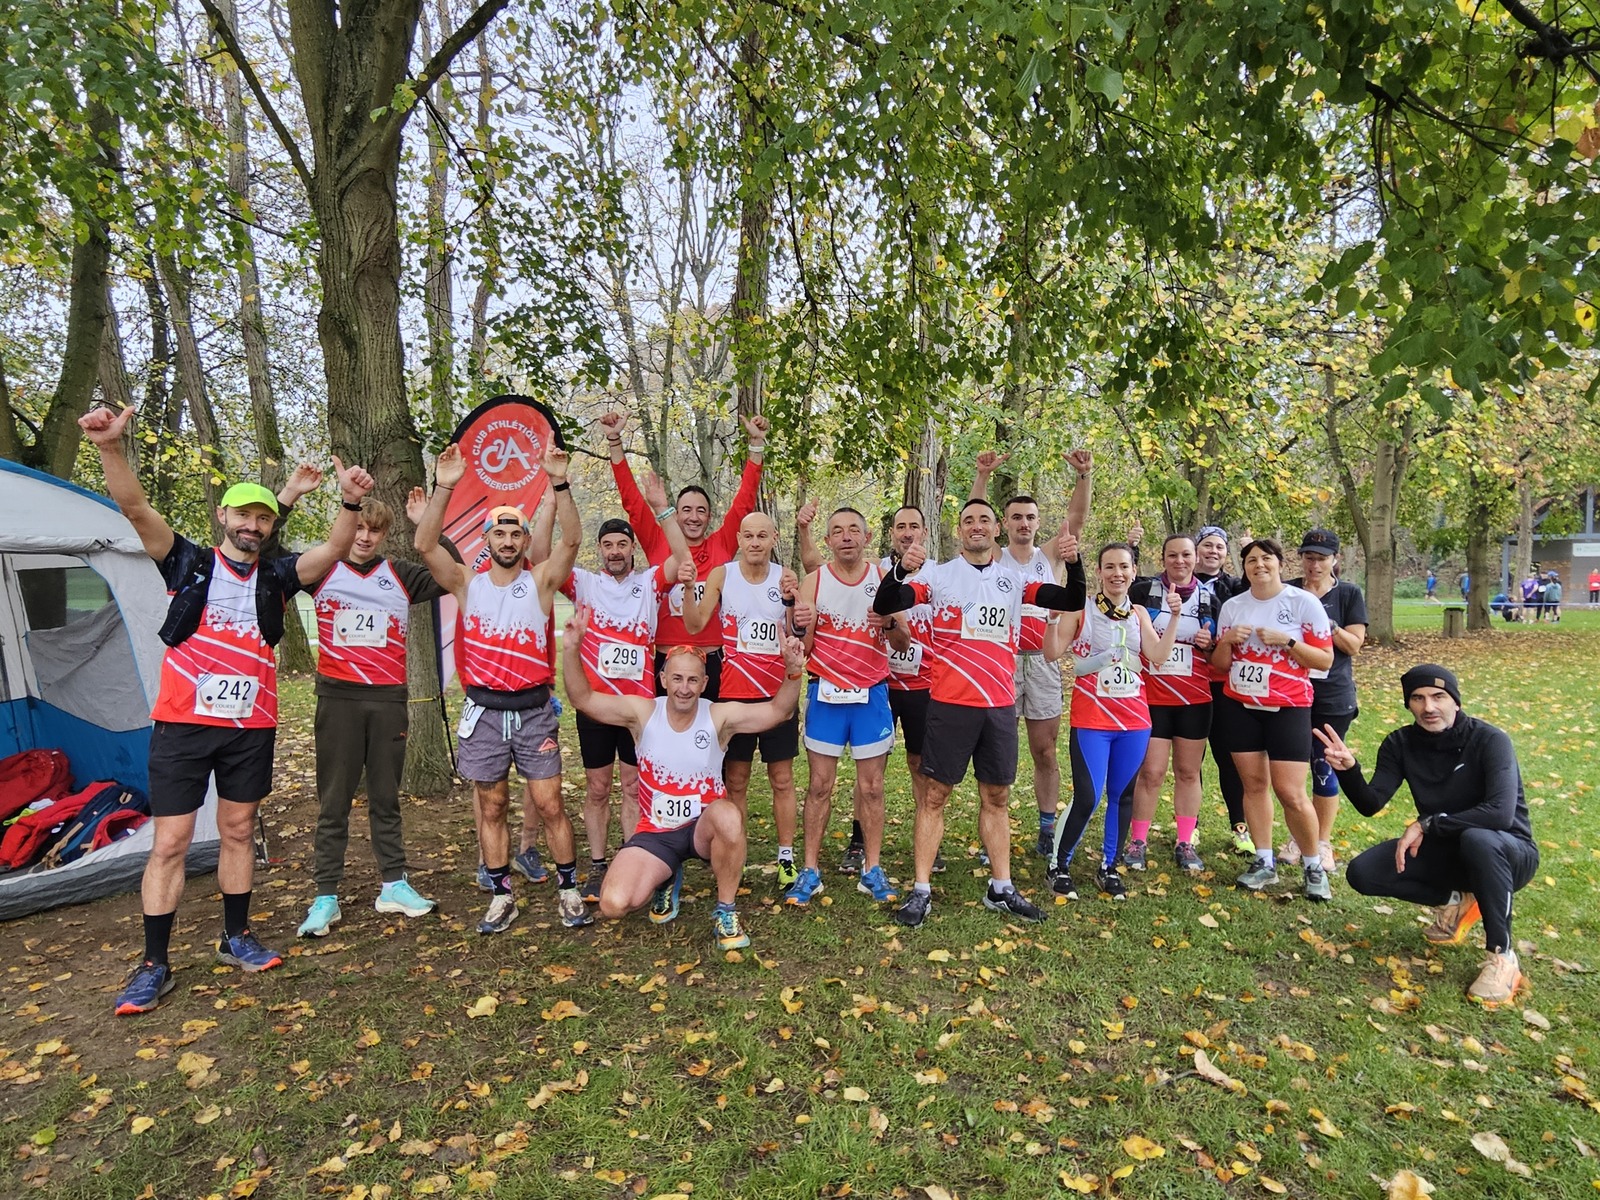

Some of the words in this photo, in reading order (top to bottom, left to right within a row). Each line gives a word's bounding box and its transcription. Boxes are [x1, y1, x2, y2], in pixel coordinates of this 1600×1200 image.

[472, 430, 488, 456] CLUB
[487, 419, 541, 450] ATHLÉTIQUE
[475, 463, 541, 491] AUBERGENVILLE
[355, 613, 375, 631] 24
[978, 605, 1006, 627] 382
[750, 621, 776, 641] 390
[612, 647, 638, 666] 299
[1239, 664, 1264, 683] 423
[217, 679, 252, 701] 242
[666, 799, 692, 818] 318
